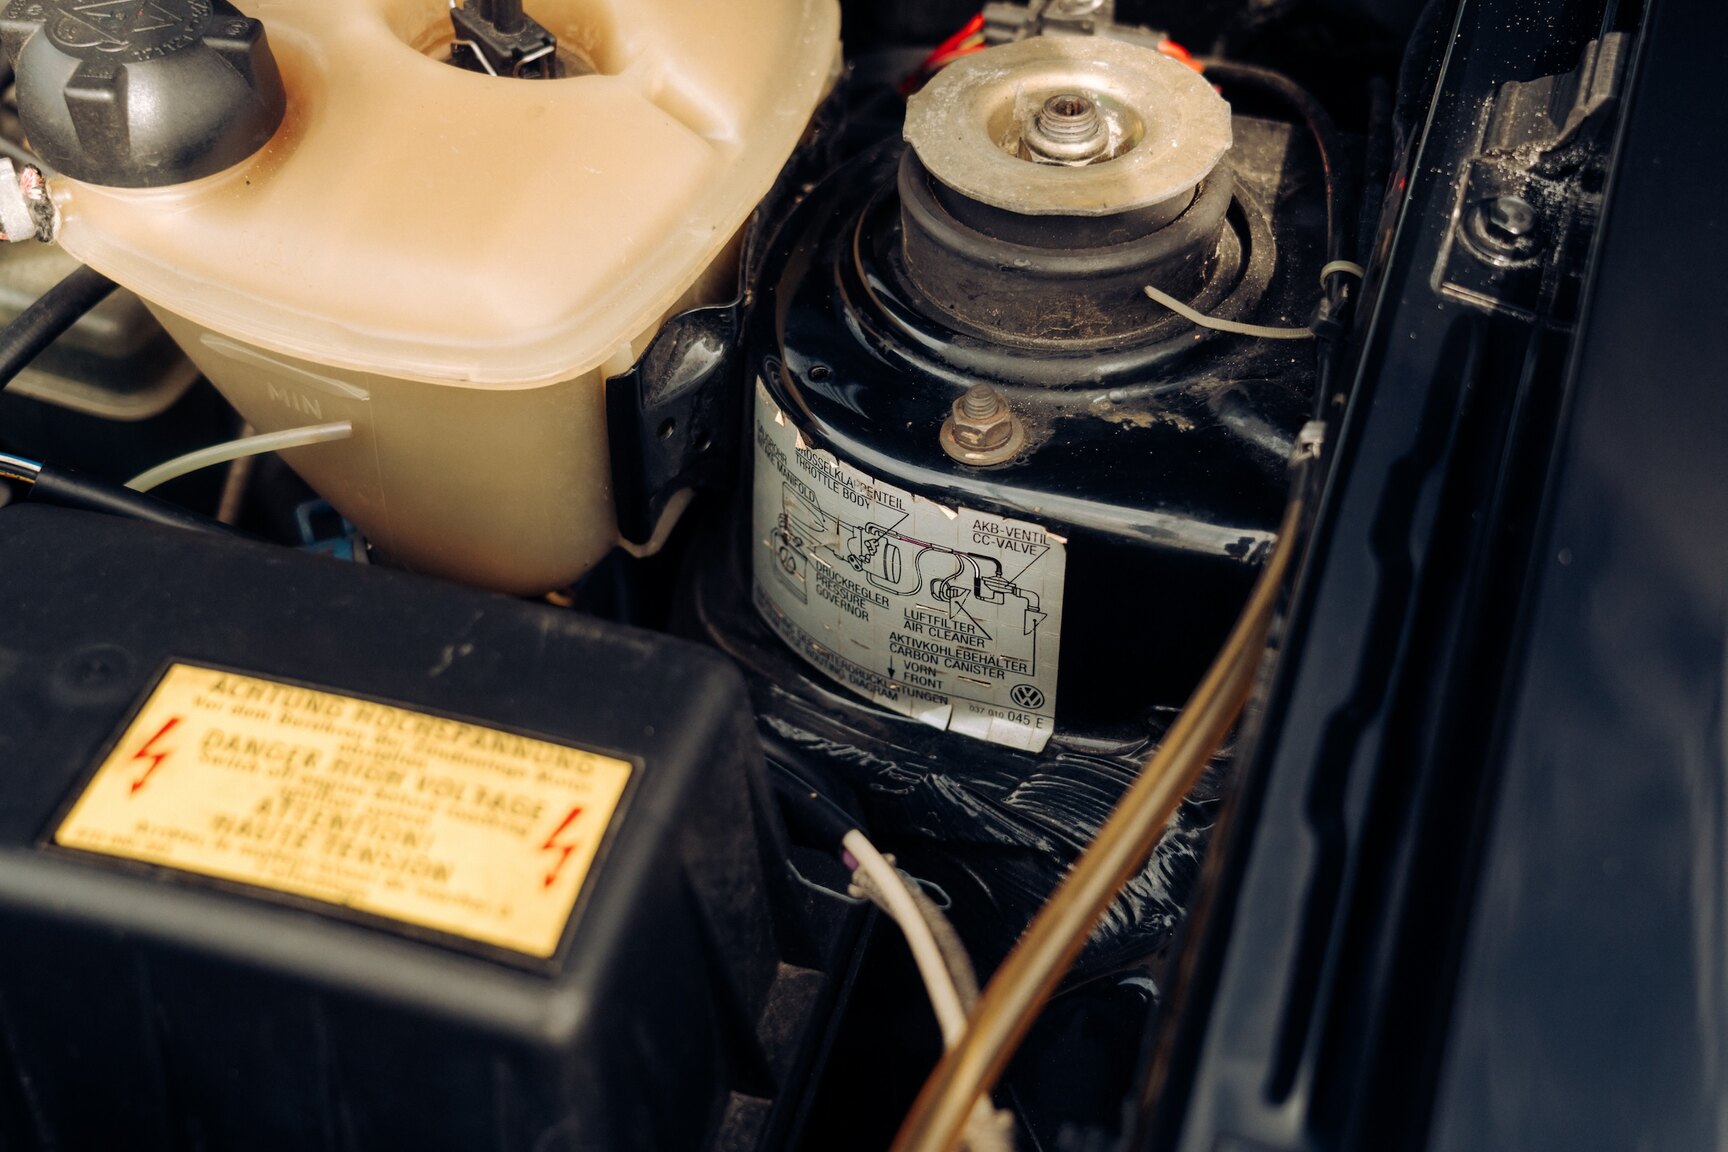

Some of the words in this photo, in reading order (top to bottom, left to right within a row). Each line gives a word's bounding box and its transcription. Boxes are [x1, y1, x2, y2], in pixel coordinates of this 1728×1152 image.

[267, 382, 322, 419] MIN
[777, 461, 815, 502] MANIFOLD
[795, 453, 840, 494] THROTTLE
[843, 488, 870, 509] BODY
[973, 520, 1050, 545] AKB-VENTIL
[973, 533, 1037, 555] CC-VALVE
[816, 560, 889, 607] DRUCKREGLER
[816, 572, 866, 609] PRESSURE
[816, 584, 869, 621] GOVERNOR
[904, 608, 976, 634] LUFTFILTER
[889, 632, 1027, 672] AKTIVKOHLEBEHÄLTER
[903, 621, 923, 634] AIR
[929, 626, 985, 648] CLEANER
[889, 643, 938, 665] CARBON
[944, 659, 1005, 680] CANISTER
[903, 660, 937, 677] VORN
[206, 675, 348, 720] ACHTUNG
[849, 674, 898, 701] DIAGRAM
[903, 672, 944, 689] FRONT
[1007, 711, 1030, 725] 045
[1036, 718, 1044, 729] E
[197, 725, 326, 772] DANGER
